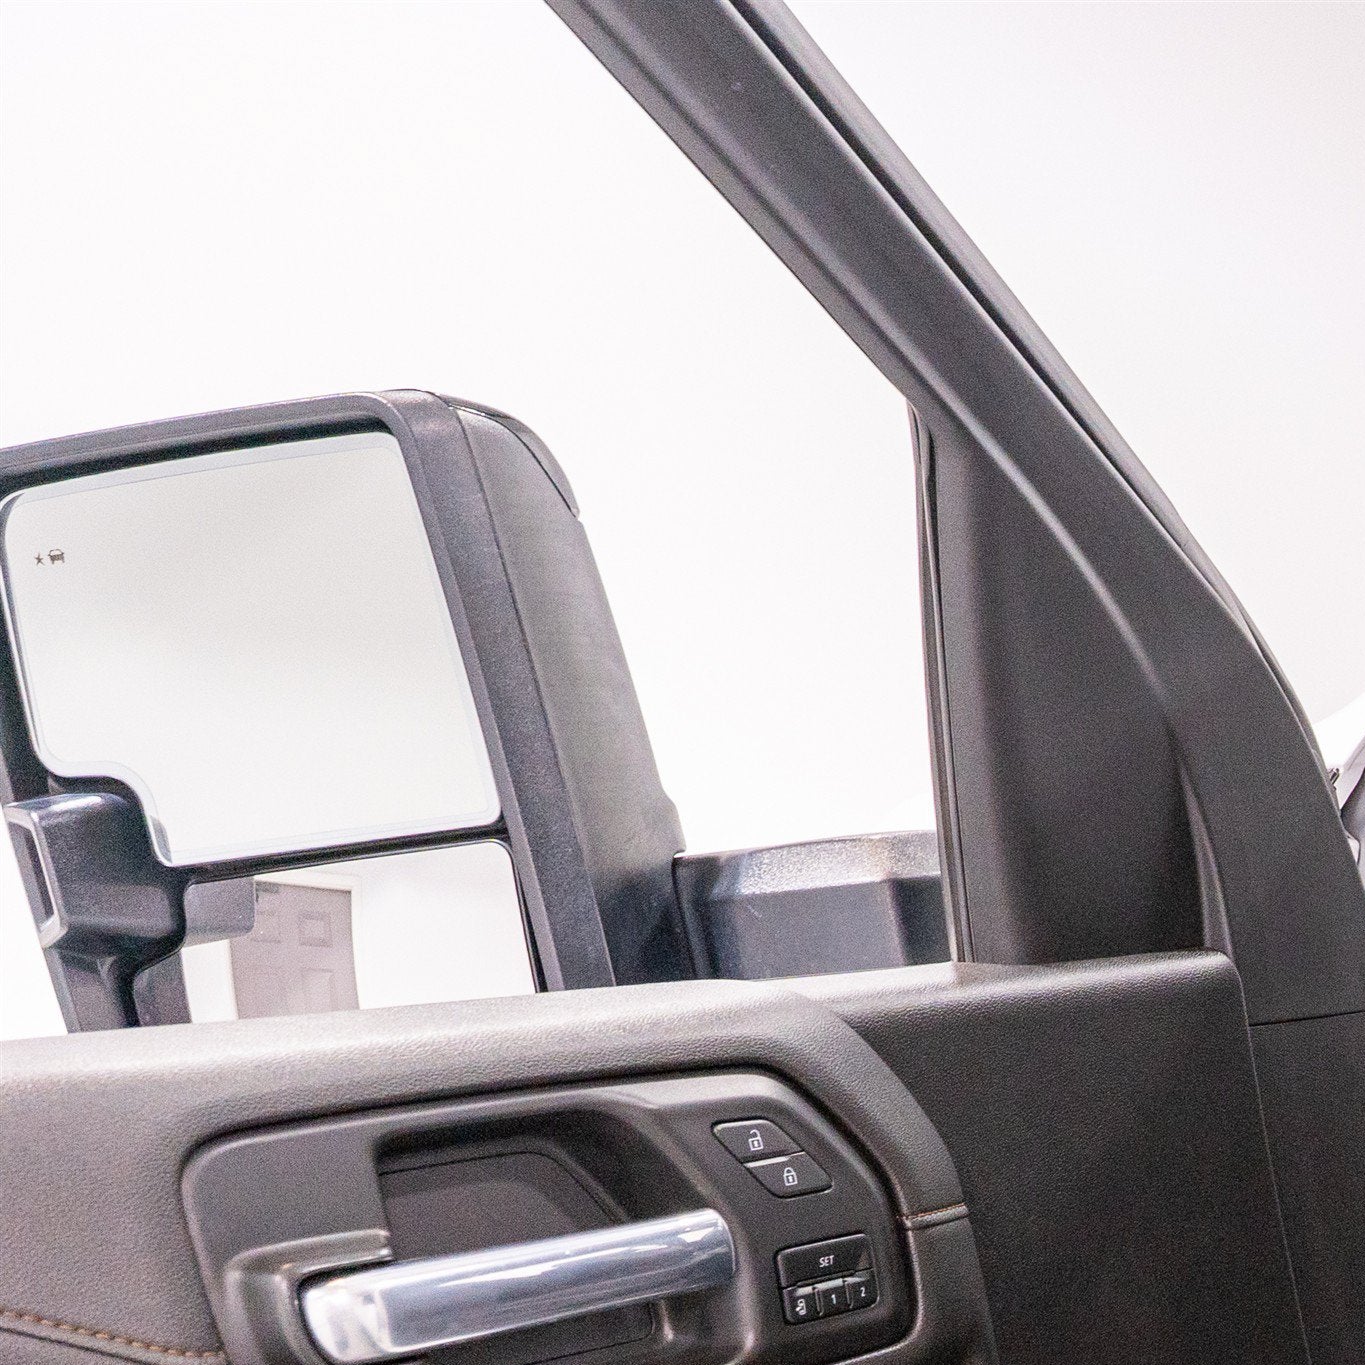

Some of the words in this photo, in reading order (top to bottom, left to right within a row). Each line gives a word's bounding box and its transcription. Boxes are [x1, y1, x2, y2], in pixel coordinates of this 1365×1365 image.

[819, 1254, 835, 1268] SET
[831, 1294, 837, 1304] 1
[860, 1286, 866, 1297] 2
